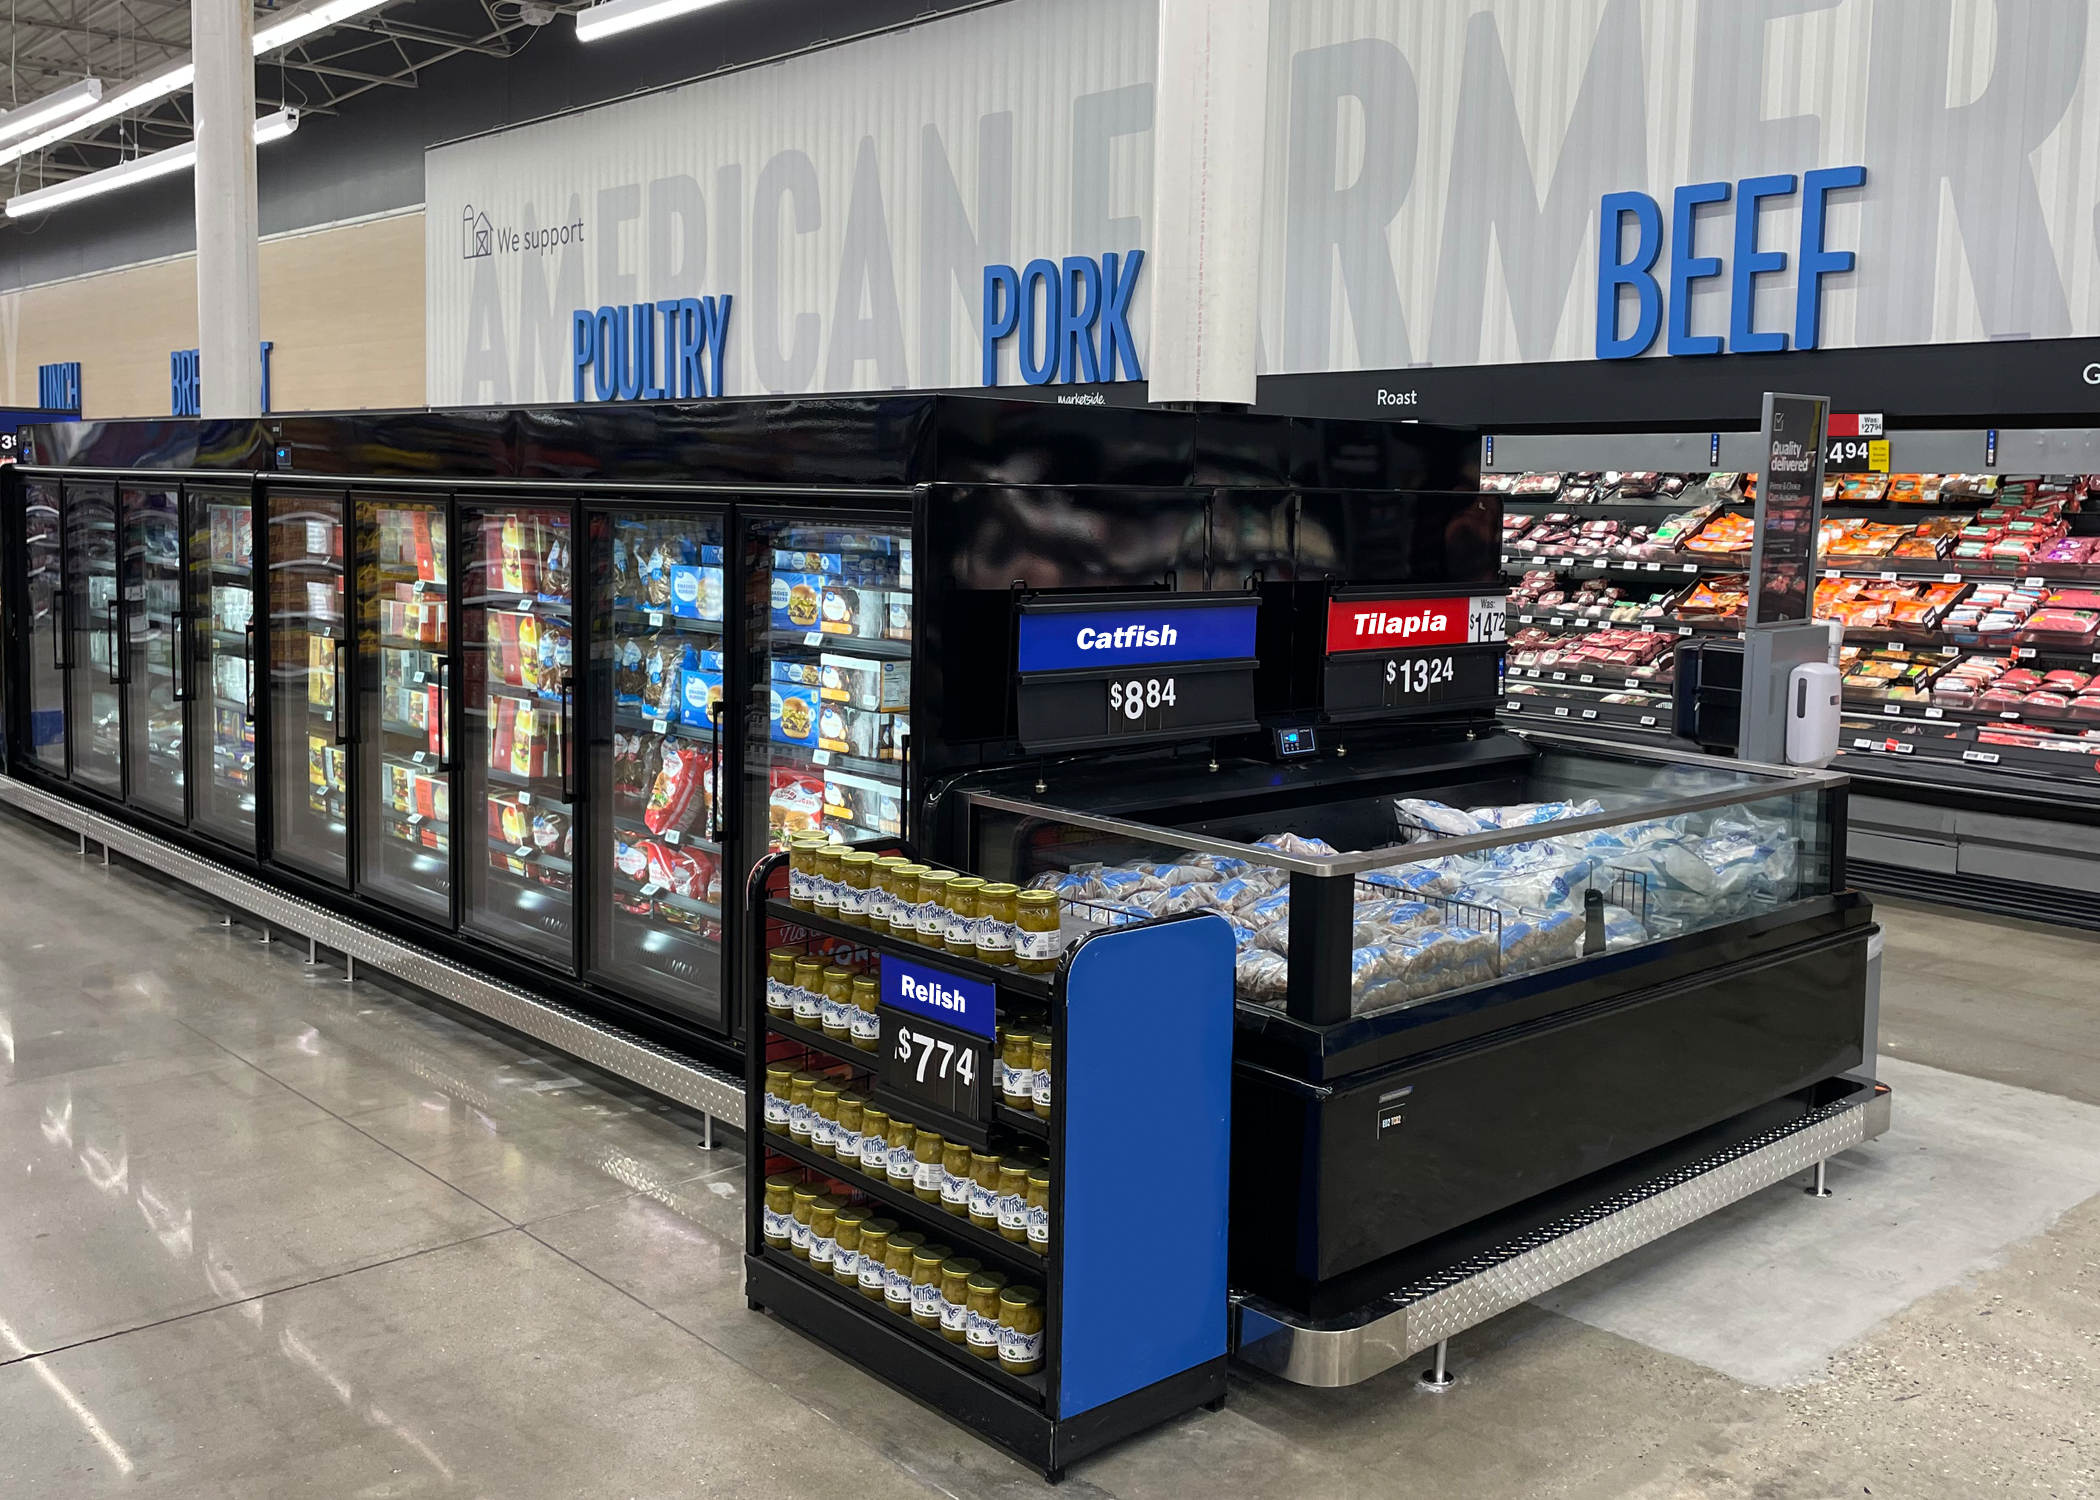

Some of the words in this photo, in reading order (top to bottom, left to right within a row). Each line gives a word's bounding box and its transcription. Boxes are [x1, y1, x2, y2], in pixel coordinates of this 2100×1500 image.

[497, 226, 519, 254] We
[524, 218, 584, 256] support
[1596, 166, 1867, 360] BEEF
[982, 250, 1145, 387] PORK
[573, 294, 733, 403] POULTRY
[1377, 389, 1418, 405] Roast
[1771, 456, 1808, 471] delivered
[1772, 440, 1802, 458] Quality
[1480, 599, 1496, 608] Was:
[1077, 624, 1177, 650] Catfish
[1354, 610, 1447, 637] Tilapia
[1386, 657, 1454, 693] $1324
[1110, 678, 1176, 719] $884
[901, 974, 965, 1013] Relish
[898, 1027, 974, 1086] $774
